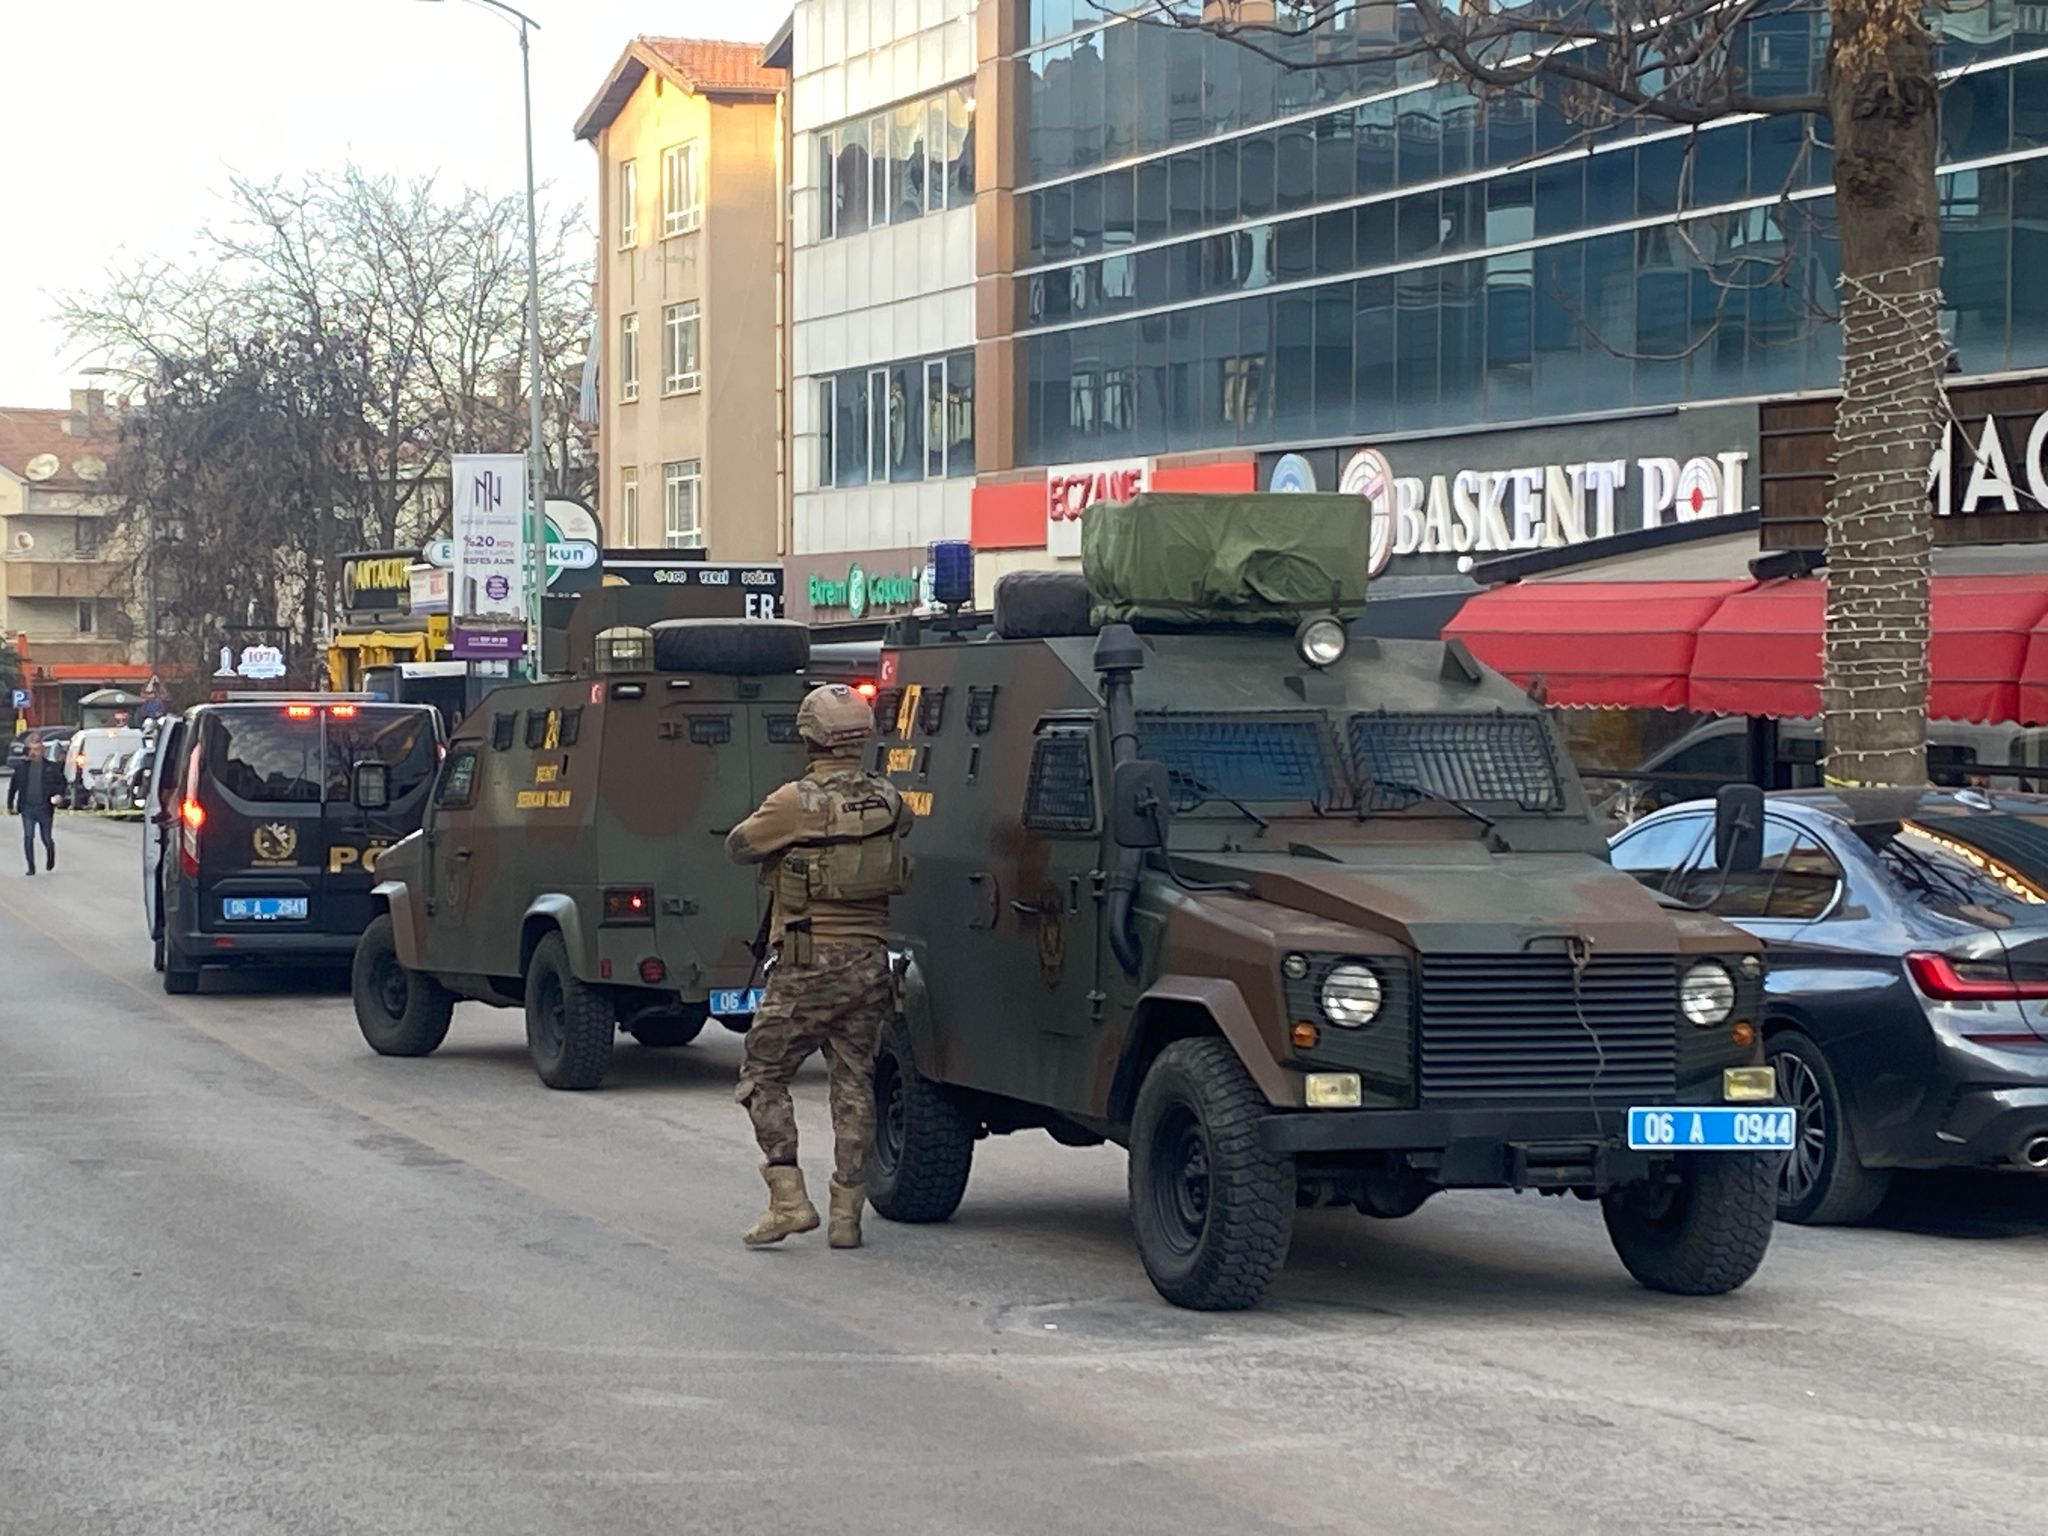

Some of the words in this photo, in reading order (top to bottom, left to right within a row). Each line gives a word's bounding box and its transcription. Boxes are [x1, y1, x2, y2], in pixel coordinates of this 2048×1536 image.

[720, 992, 739, 1009] 06
[1644, 1113, 1675, 1143] 06
[1689, 1113, 1705, 1143] A
[1733, 1113, 1791, 1143] 0944
